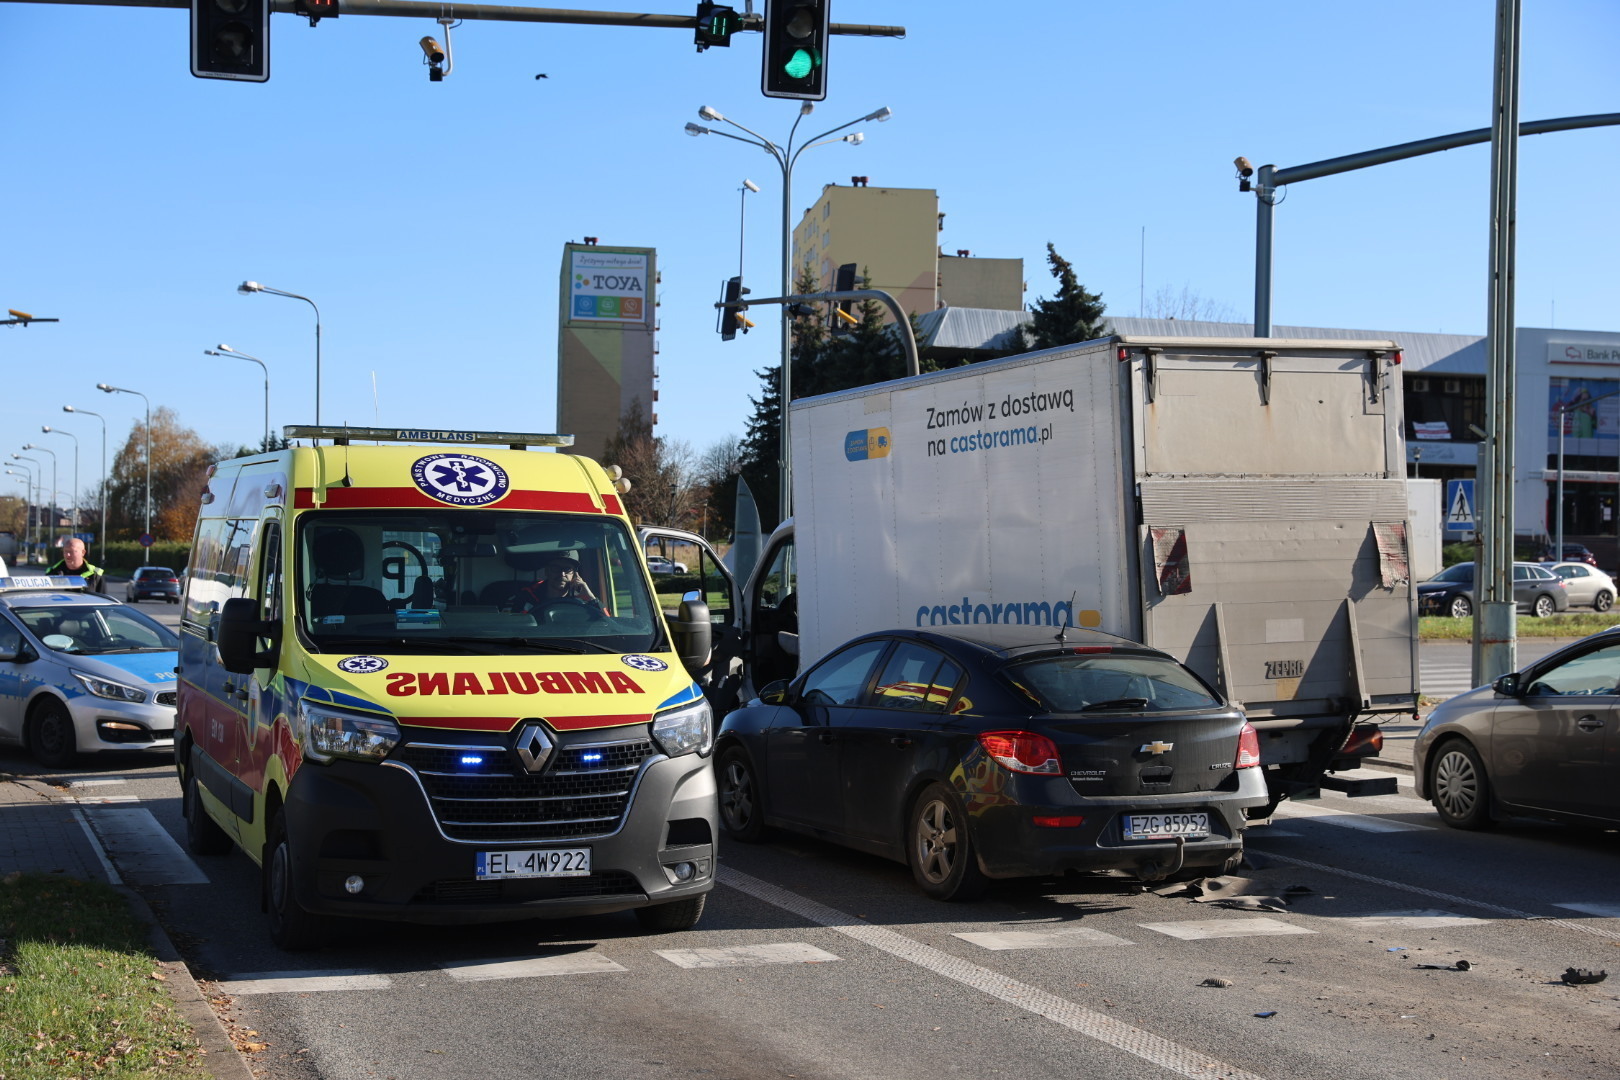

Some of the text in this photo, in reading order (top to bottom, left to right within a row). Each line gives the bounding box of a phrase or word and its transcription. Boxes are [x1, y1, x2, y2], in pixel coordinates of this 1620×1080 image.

[712, 17, 726, 35] 11
[593, 275, 642, 291] TOYA
[1587, 349, 1610, 360] Bank
[926, 389, 1074, 430] Zamów z dostawą
[398, 431, 474, 440] AMBULANS
[927, 423, 1053, 457] na castorama.pl
[460, 454, 506, 488] RATOWNICTWO
[436, 492, 496, 504] MEDYCZNE
[14, 578, 51, 588] POLICJA
[916, 597, 1074, 628] castorama
[154, 671, 176, 680] PO
[1132, 816, 1160, 834] EZG
[1164, 814, 1206, 832] 85952
[490, 854, 516, 874] EL
[524, 852, 586, 872] 4W922
